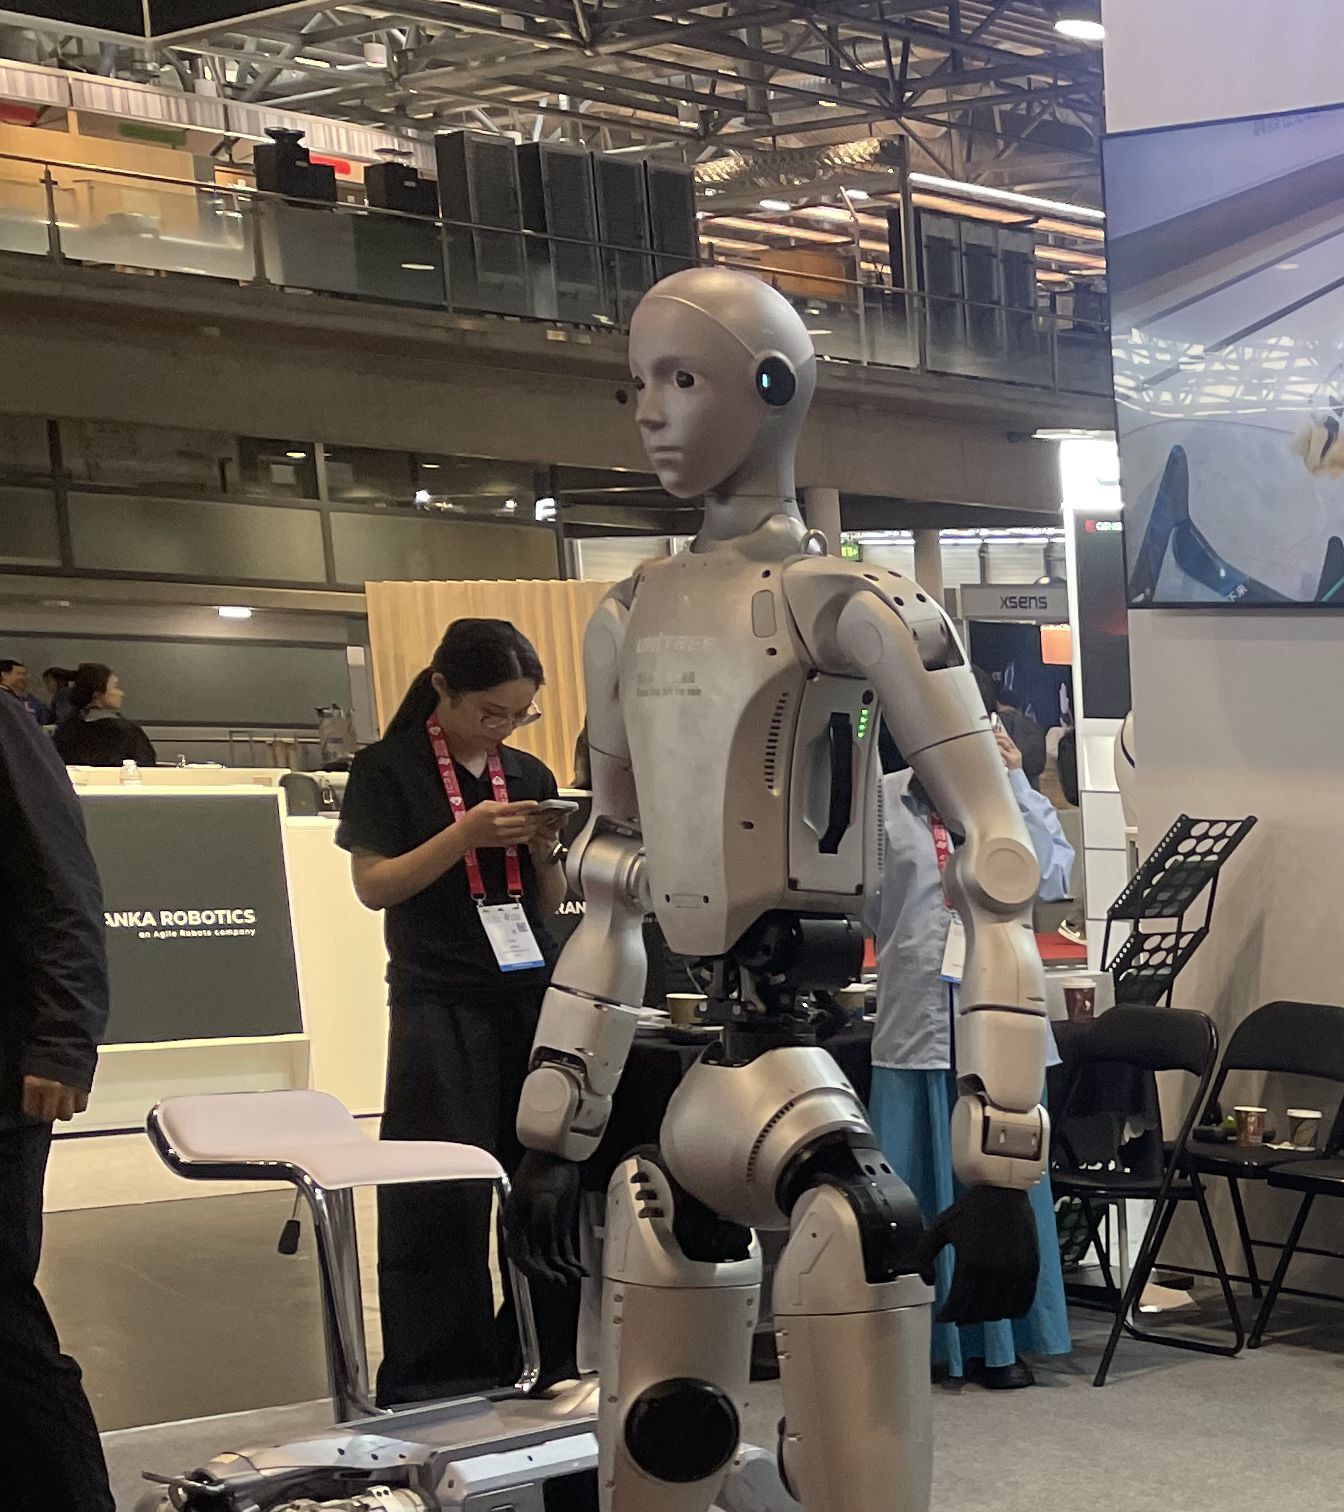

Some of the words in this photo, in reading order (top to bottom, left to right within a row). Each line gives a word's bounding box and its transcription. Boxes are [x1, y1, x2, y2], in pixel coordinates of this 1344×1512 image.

[1000, 595, 1048, 609] xsens
[159, 909, 256, 927] ROBOTICS
[138, 931, 151, 939] an
[153, 930, 178, 940] Agile
[180, 929, 212, 938] Robots
[214, 928, 256, 938] company
